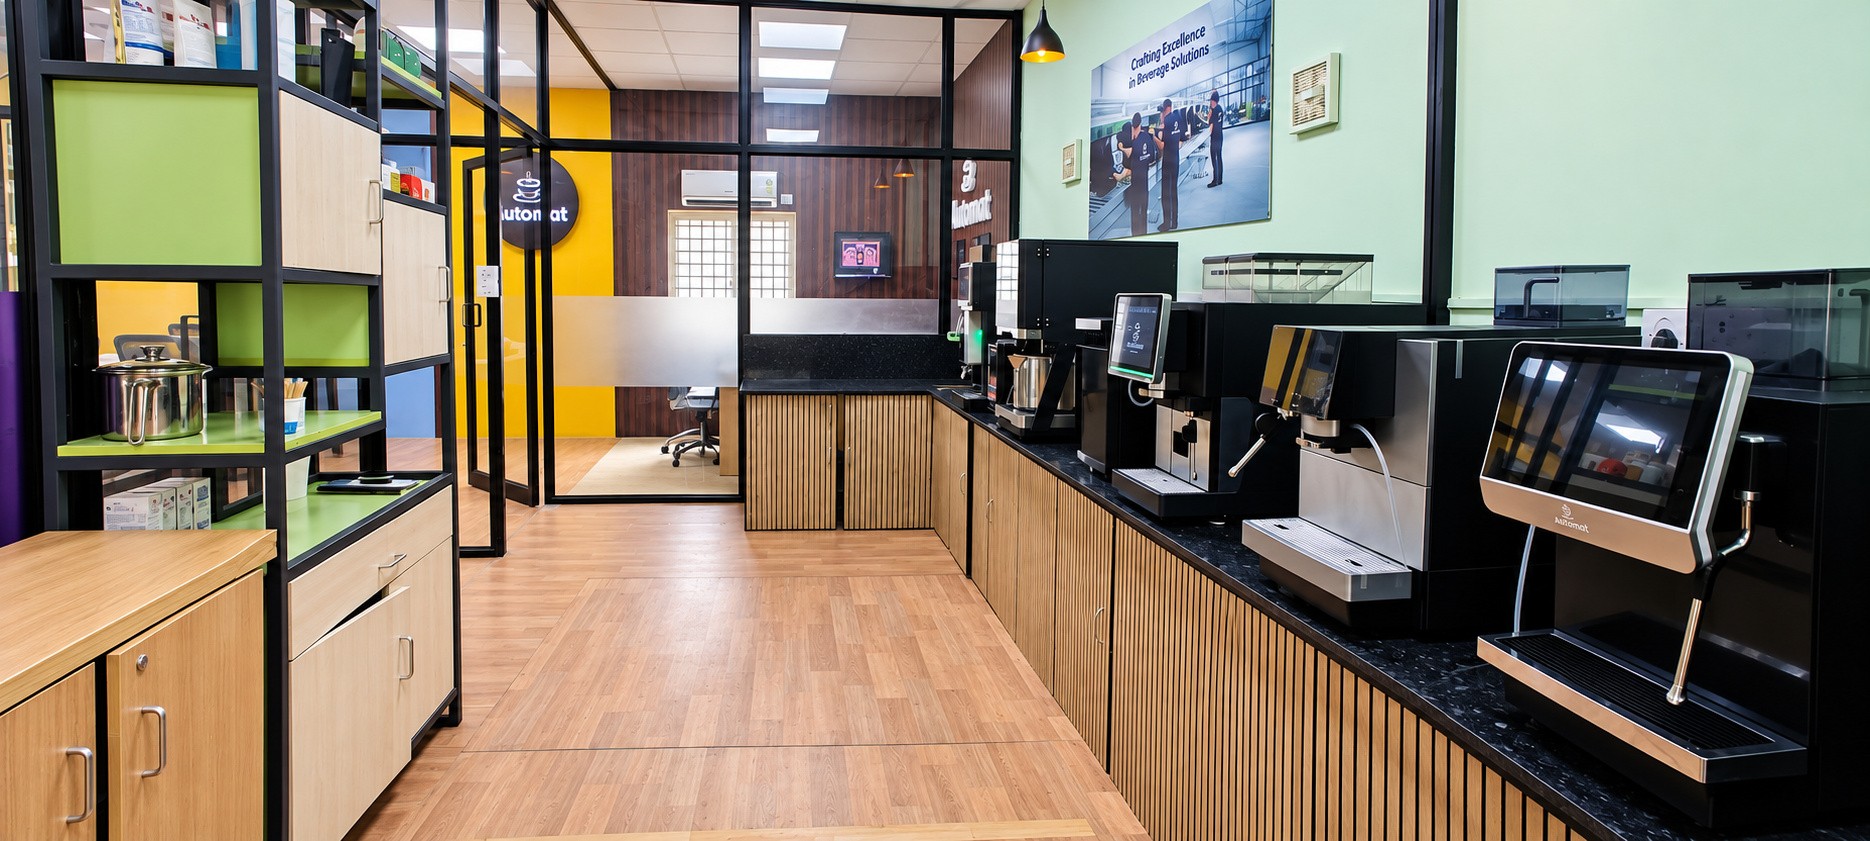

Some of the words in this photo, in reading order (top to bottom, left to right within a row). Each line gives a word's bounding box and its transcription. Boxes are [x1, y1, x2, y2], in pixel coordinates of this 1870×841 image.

[1128, 77, 1136, 89] in
[1137, 63, 1170, 85] Beverage
[1171, 44, 1210, 70] Solutions
[1131, 48, 1161, 71] Crafting
[1162, 26, 1206, 56] Excellence
[501, 206, 569, 222] utomat
[951, 189, 992, 230] utomat
